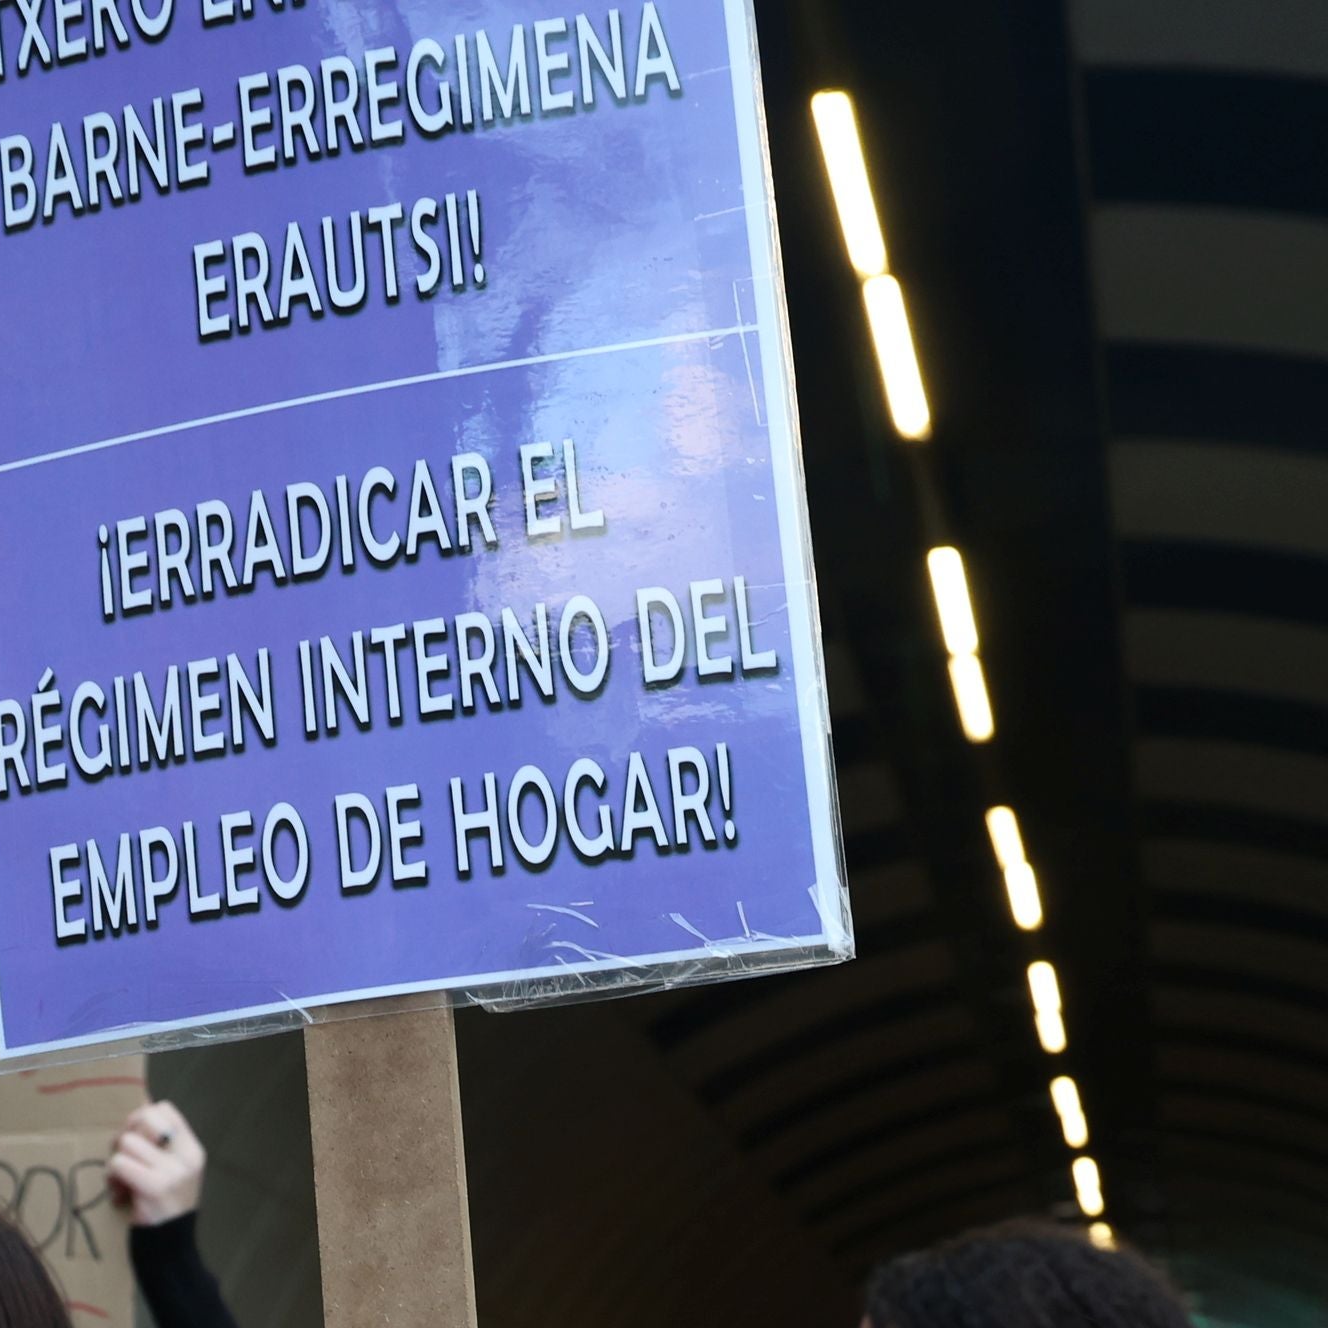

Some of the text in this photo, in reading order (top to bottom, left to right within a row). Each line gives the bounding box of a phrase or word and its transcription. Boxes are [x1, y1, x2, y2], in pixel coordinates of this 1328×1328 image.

[194, 190, 485, 338] ERAUTSI!
[98, 439, 605, 616] ¡ERRADICAR EL
[299, 594, 610, 734] INTERNO
[635, 575, 777, 685] DEL
[50, 742, 737, 943] EMPLEO DE HOGAR!
